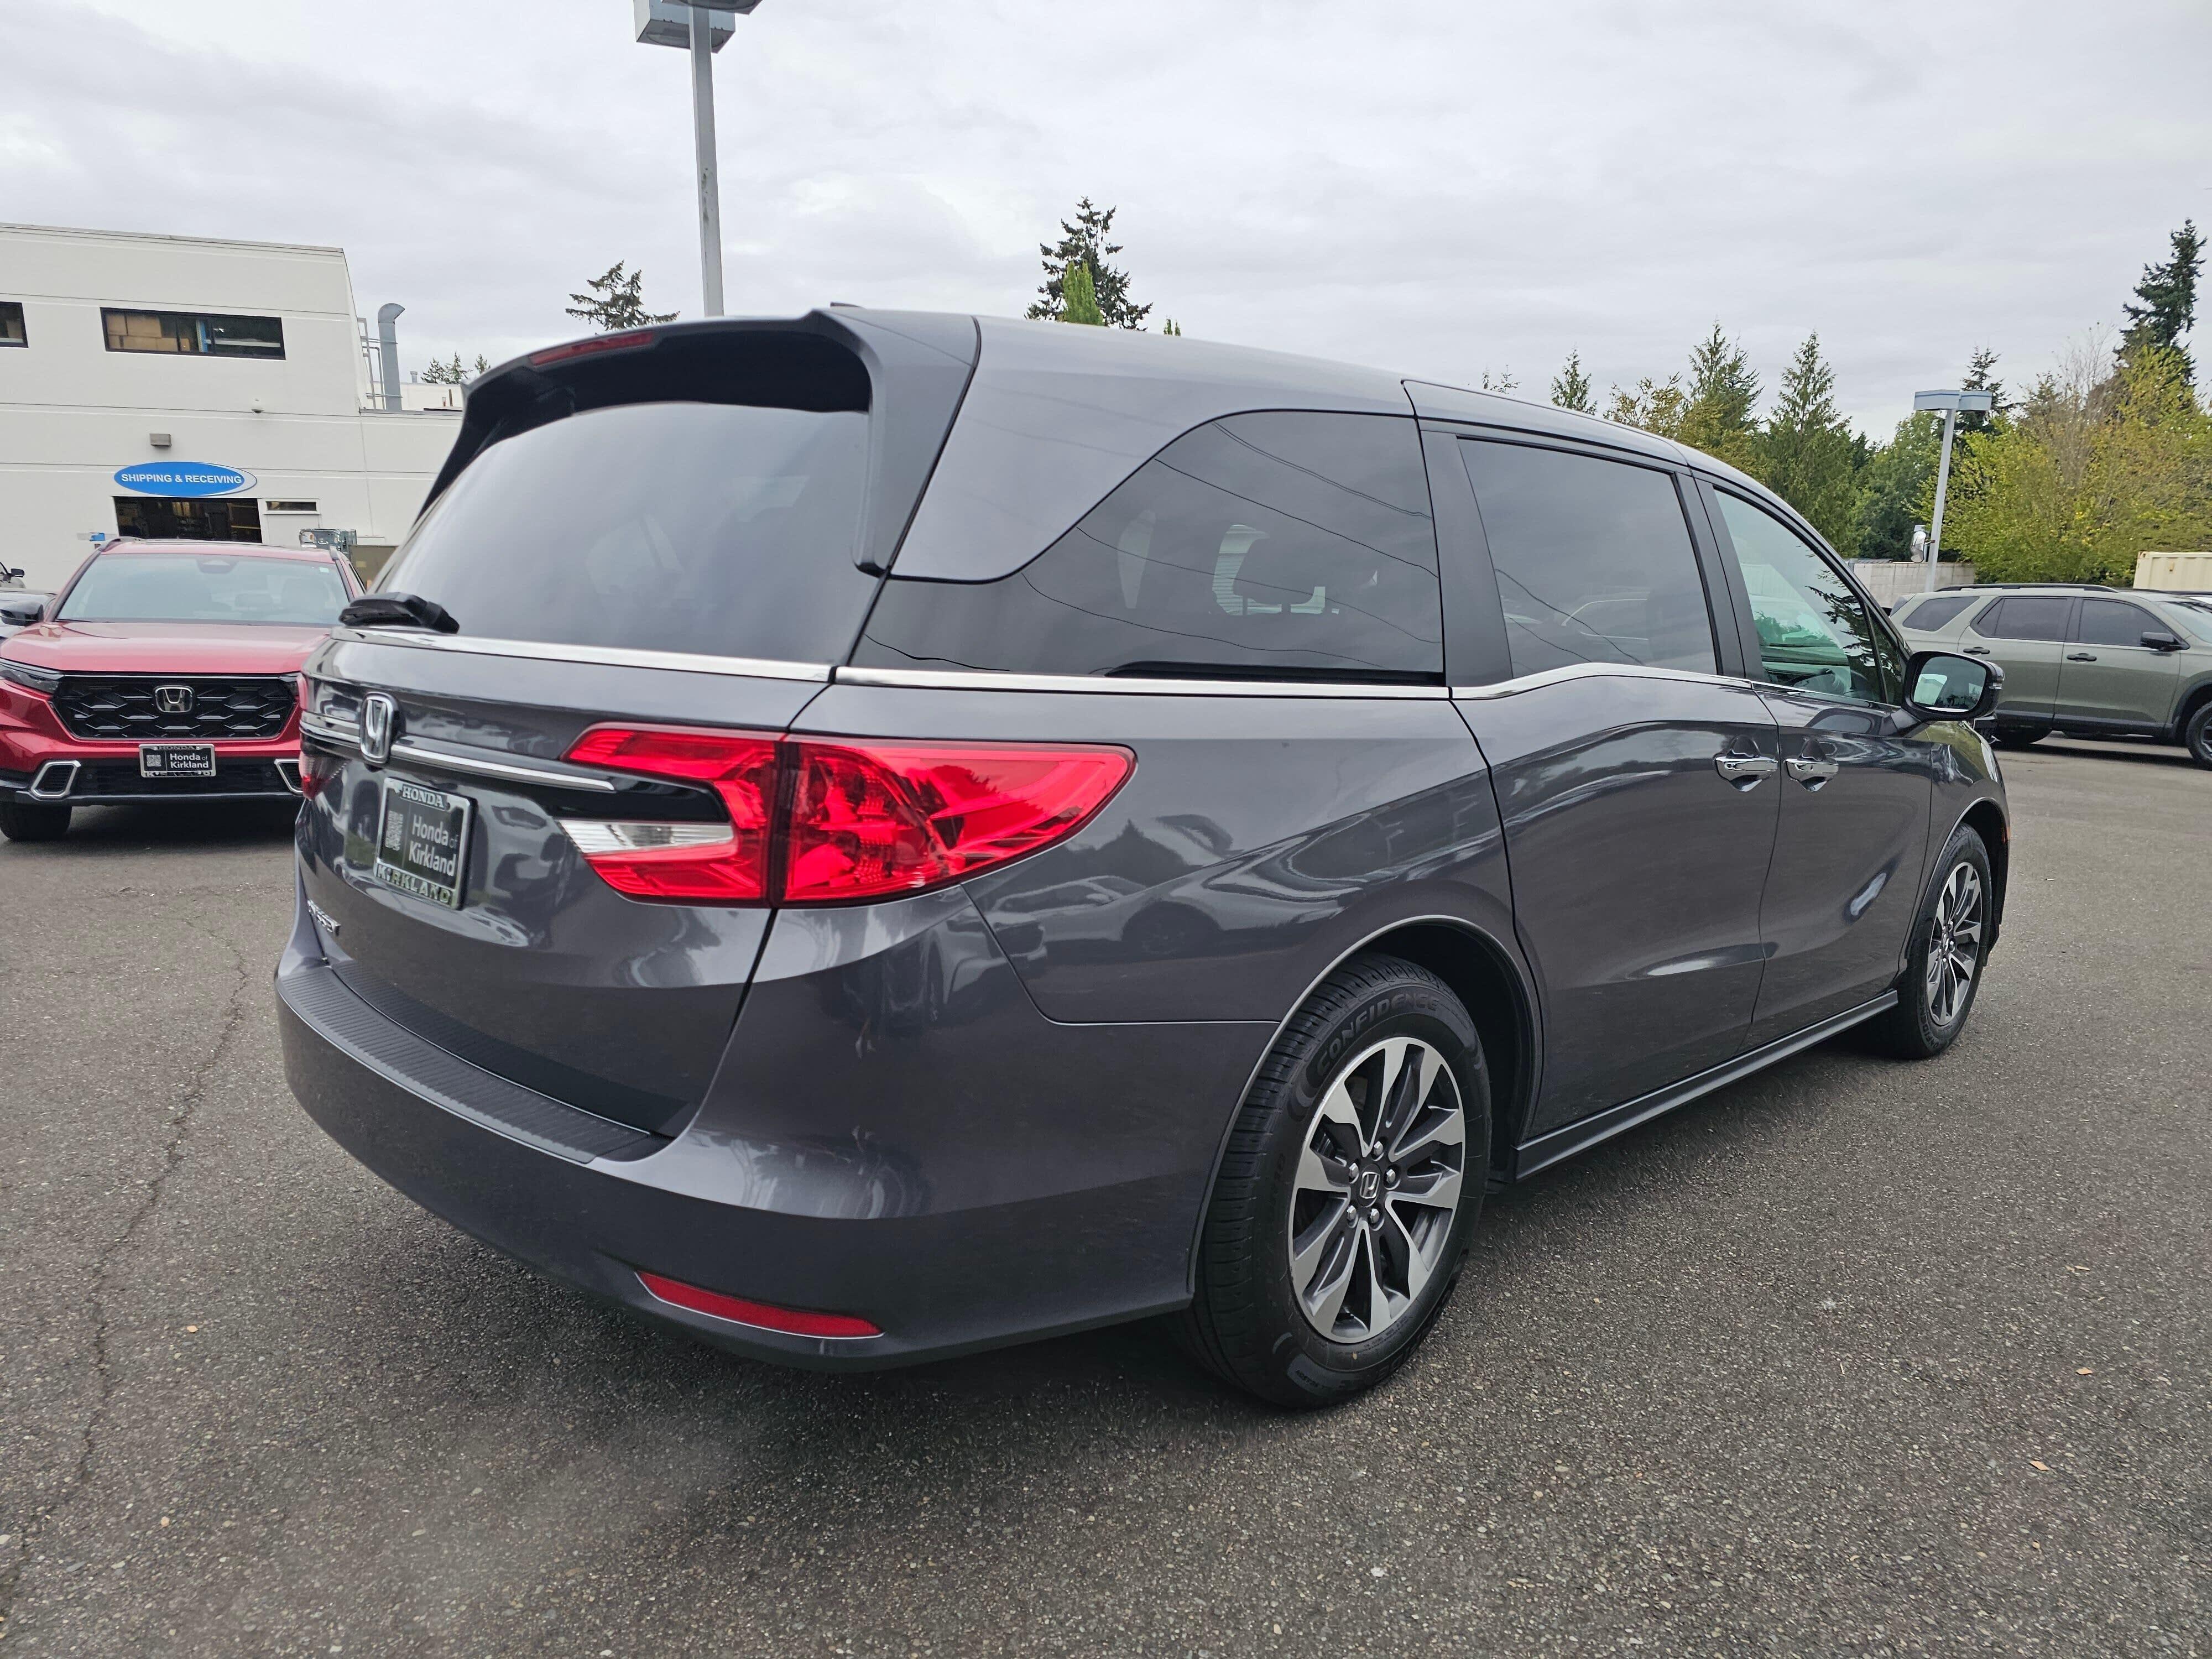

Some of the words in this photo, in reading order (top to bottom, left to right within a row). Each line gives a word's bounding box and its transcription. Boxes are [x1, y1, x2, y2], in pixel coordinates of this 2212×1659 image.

[121, 474, 172, 483] SHIPPING
[185, 476, 242, 484] RECEIVING
[402, 785, 445, 808] HONDA
[412, 814, 449, 847] Honda
[450, 834, 458, 849] of
[409, 840, 456, 877] Kirkland
[1317, 993, 1439, 1076] CONFIDENCE
